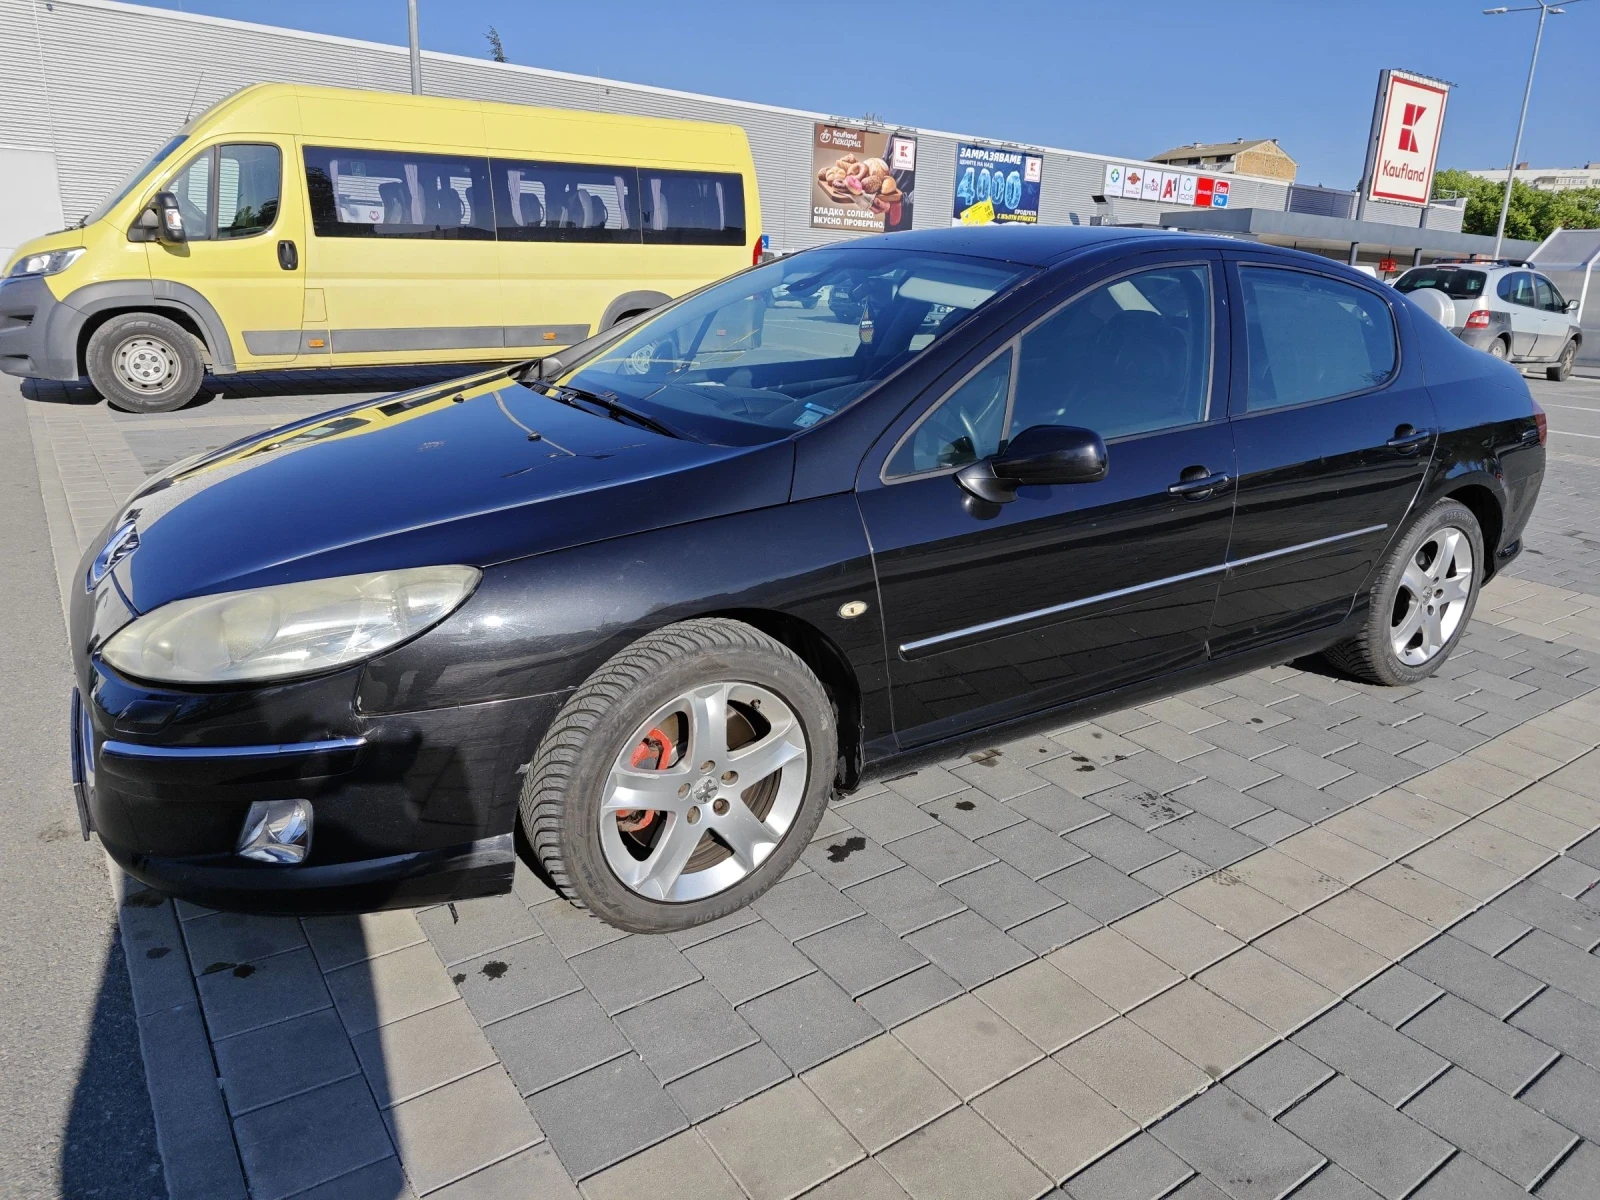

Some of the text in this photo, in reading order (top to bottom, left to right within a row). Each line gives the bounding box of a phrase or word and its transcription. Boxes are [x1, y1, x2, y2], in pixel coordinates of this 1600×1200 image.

[832, 130, 858, 140] Kaufland
[960, 147, 1022, 164] ЗАМРАЗЯВАМЕ
[1382, 159, 1426, 182] Kaufland
[957, 167, 1022, 210] 4000
[813, 206, 876, 219] СЛАДКО. СОЛЕНО.
[813, 215, 885, 229] ВКУСНО. ПРОВЕРЕНО.
